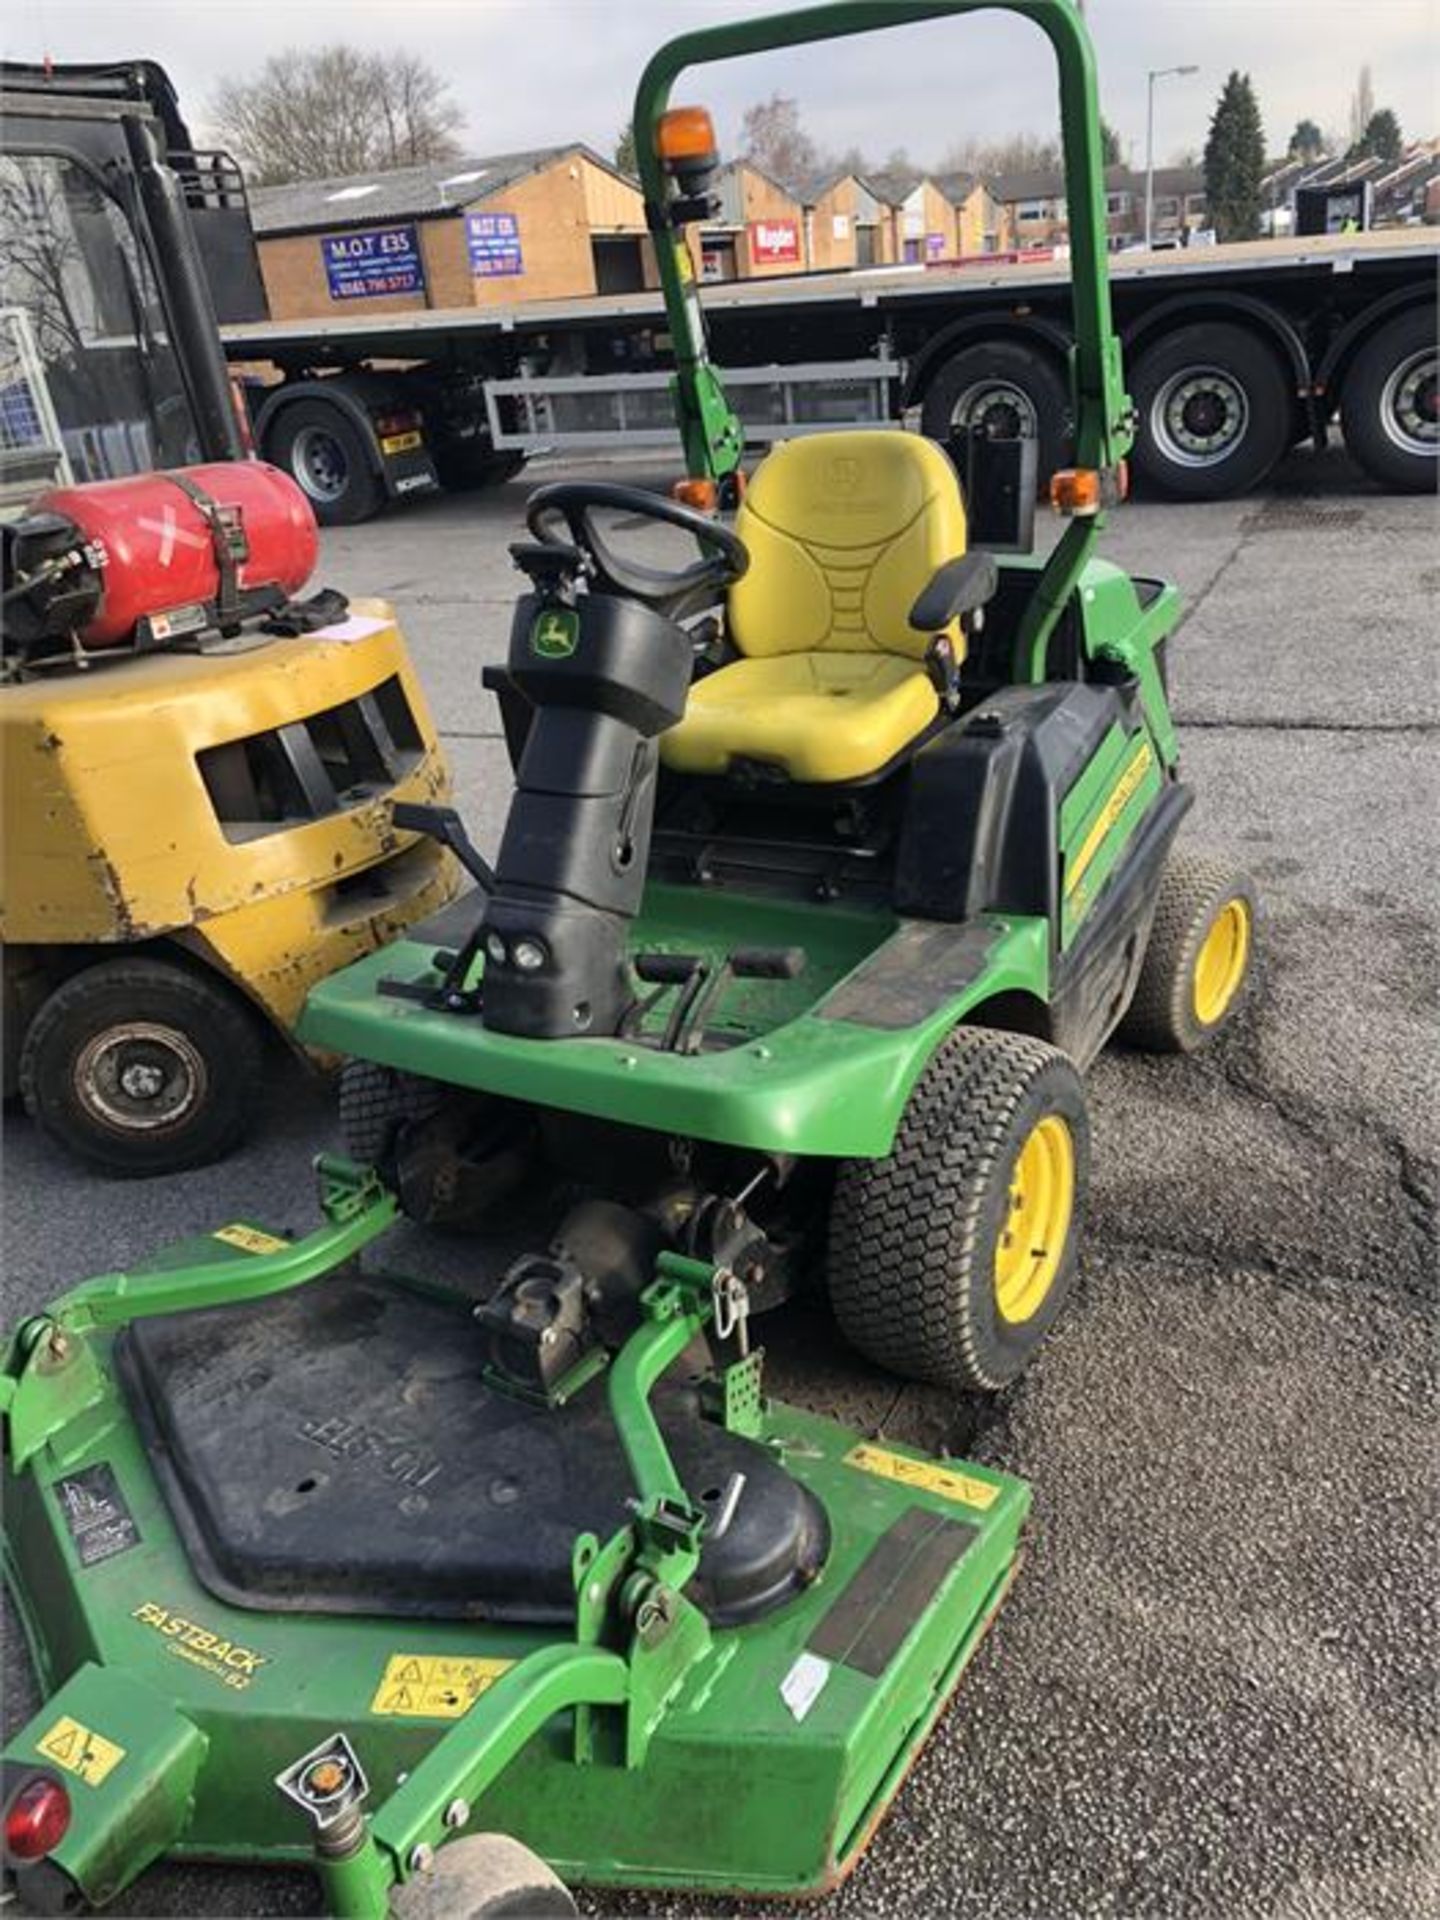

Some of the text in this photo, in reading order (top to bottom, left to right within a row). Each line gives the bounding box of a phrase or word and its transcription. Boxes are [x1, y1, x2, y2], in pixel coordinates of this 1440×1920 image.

[331, 232, 410, 259] M.O.T £35
[131, 1601, 267, 1675] FASTBACK
